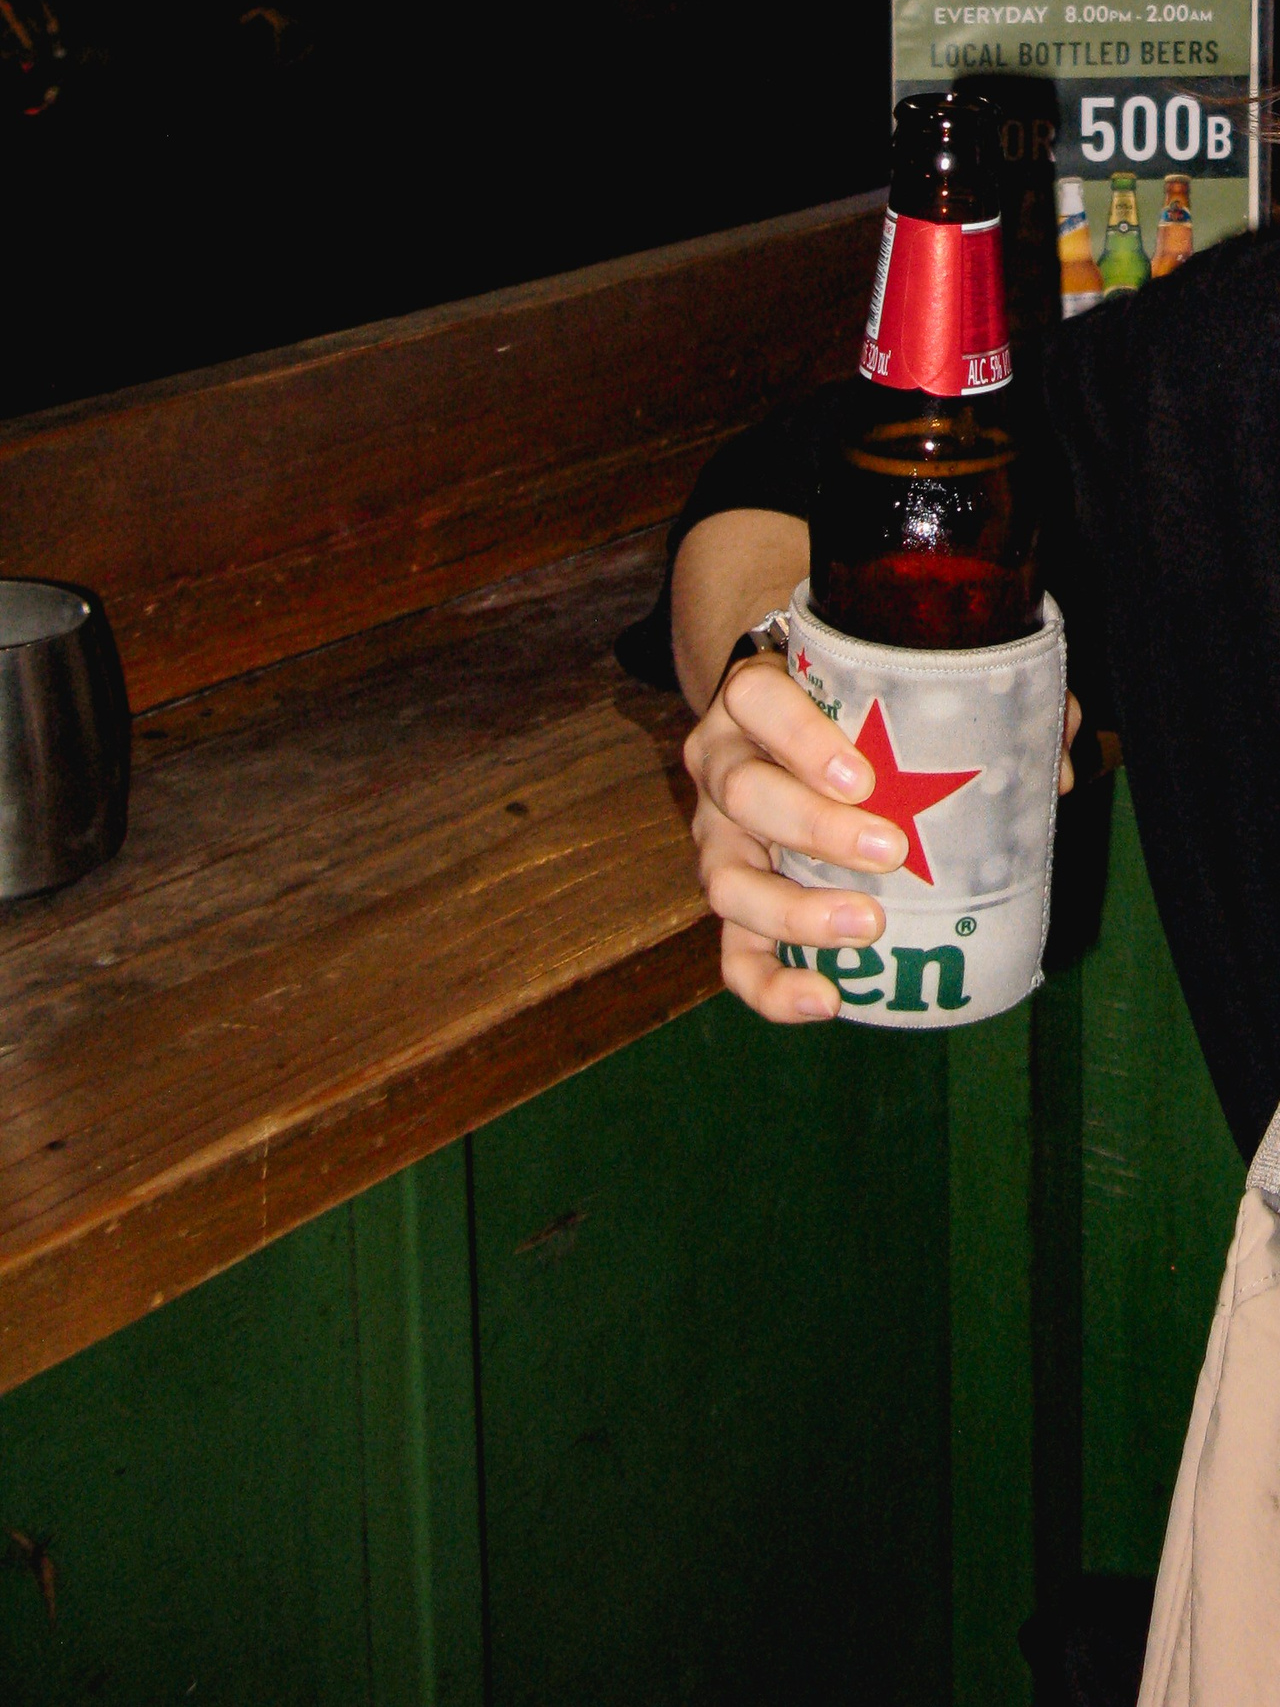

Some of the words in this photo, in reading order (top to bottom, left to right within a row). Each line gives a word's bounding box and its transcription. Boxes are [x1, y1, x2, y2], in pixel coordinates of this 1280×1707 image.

[934, 6, 1048, 25] EVERYDAY
[1064, 5, 1132, 23] 8.00PM
[1146, 4, 1213, 23] 2.00AM
[931, 42, 1006, 68] LOCAL
[1019, 41, 1130, 67] BOTTLED
[1141, 40, 1219, 65] BEERS
[1000, 118, 1056, 162] OR
[1080, 95, 1232, 162] 500B
